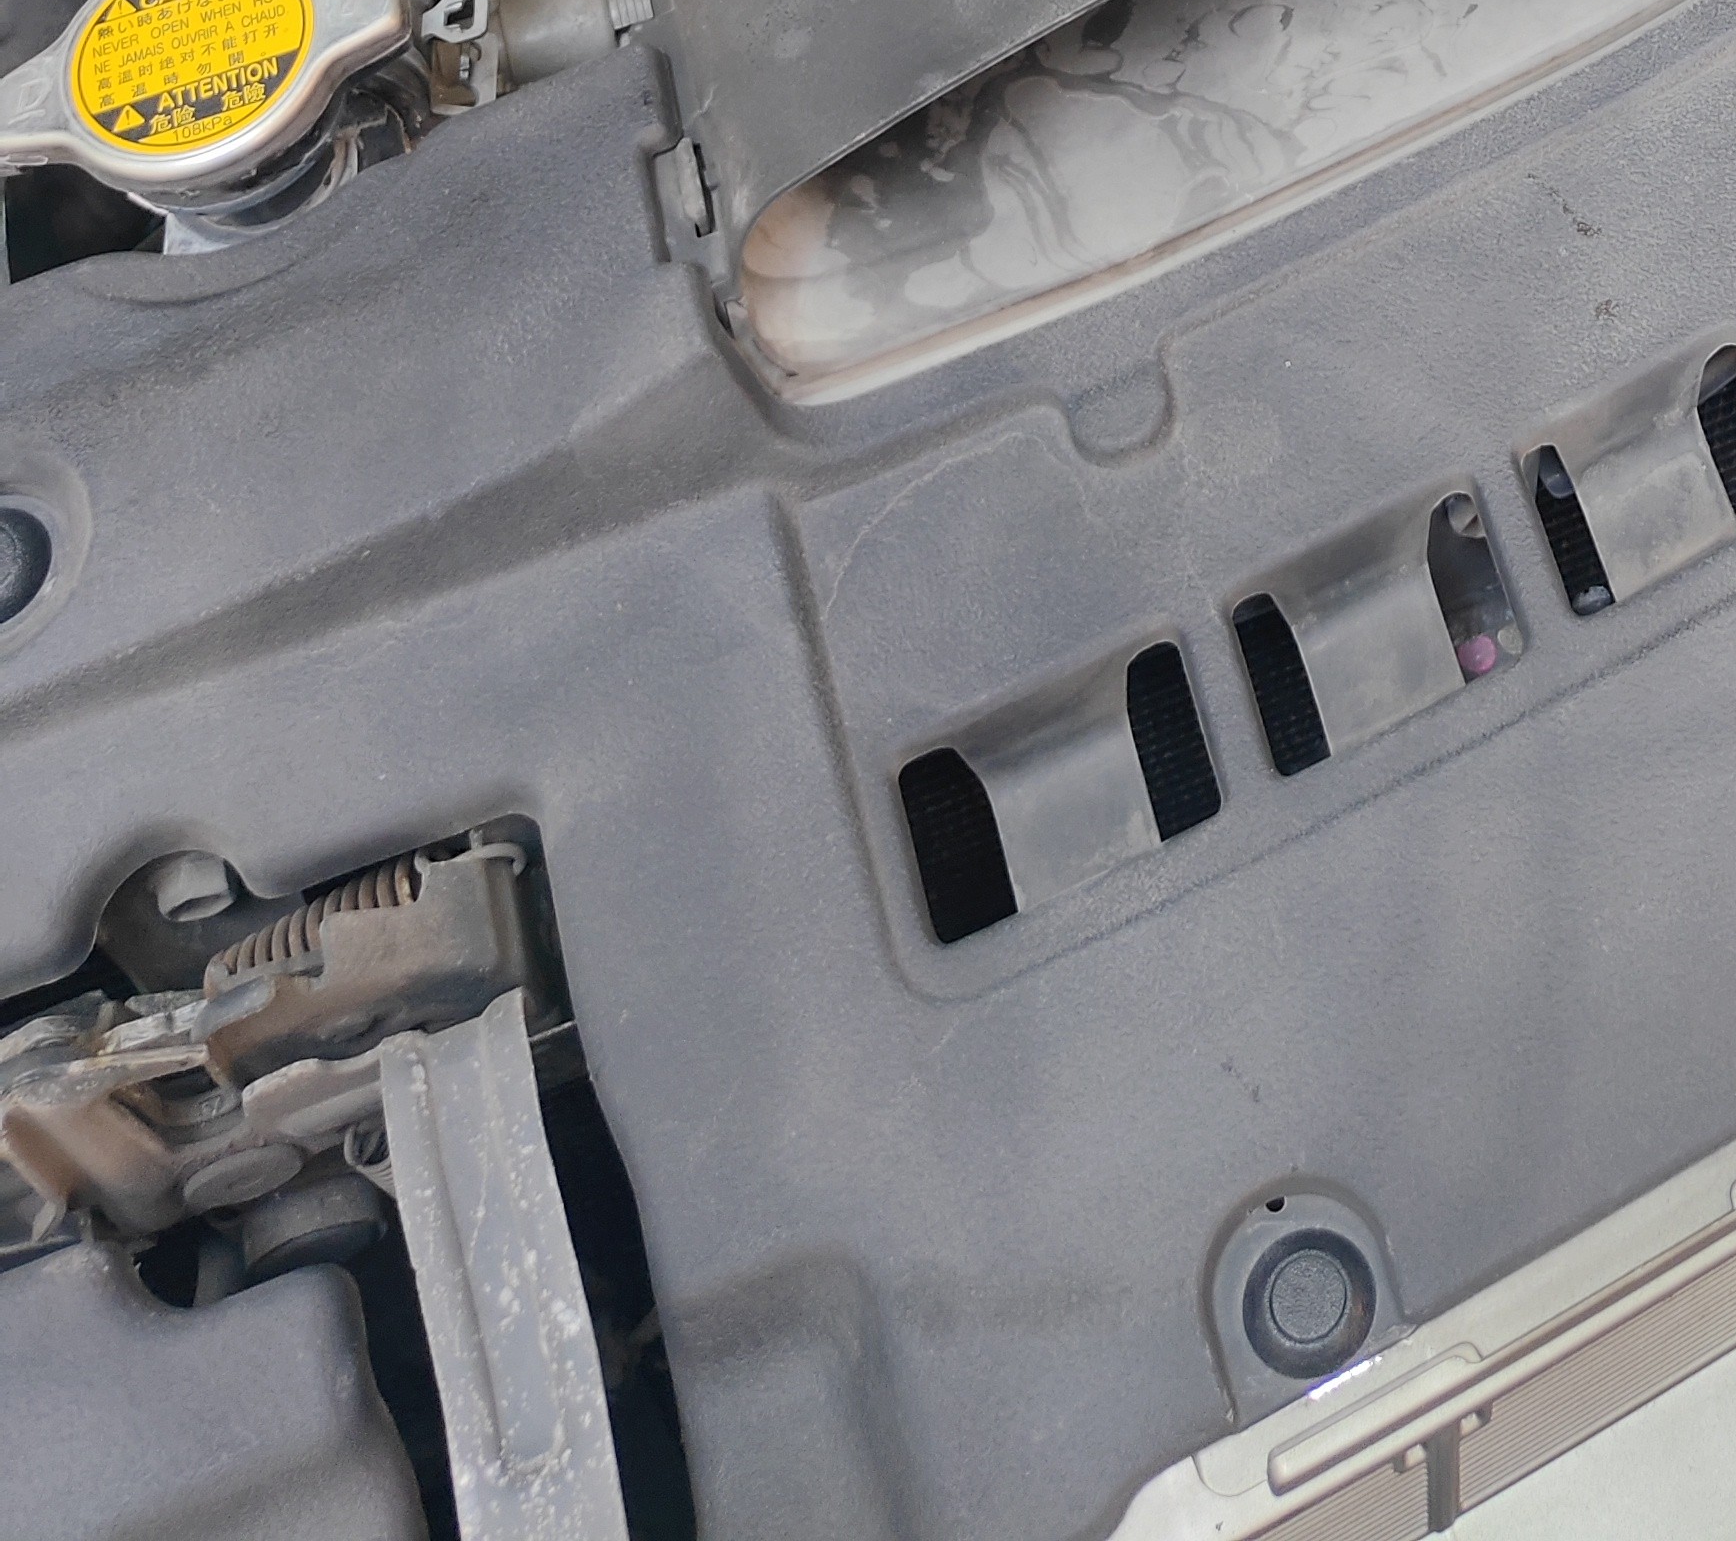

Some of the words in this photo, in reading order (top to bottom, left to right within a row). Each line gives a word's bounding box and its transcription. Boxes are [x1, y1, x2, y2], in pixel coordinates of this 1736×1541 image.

[91, 33, 139, 58] NEVER
[149, 16, 190, 39] OPEN
[199, 0, 242, 23] WHEN
[93, 59, 110, 75] NE
[117, 41, 164, 68] JAMAIS
[170, 25, 218, 49] OUVRIR
[157, 57, 278, 112] ATTENTION
[172, 114, 233, 142] 108kPa
